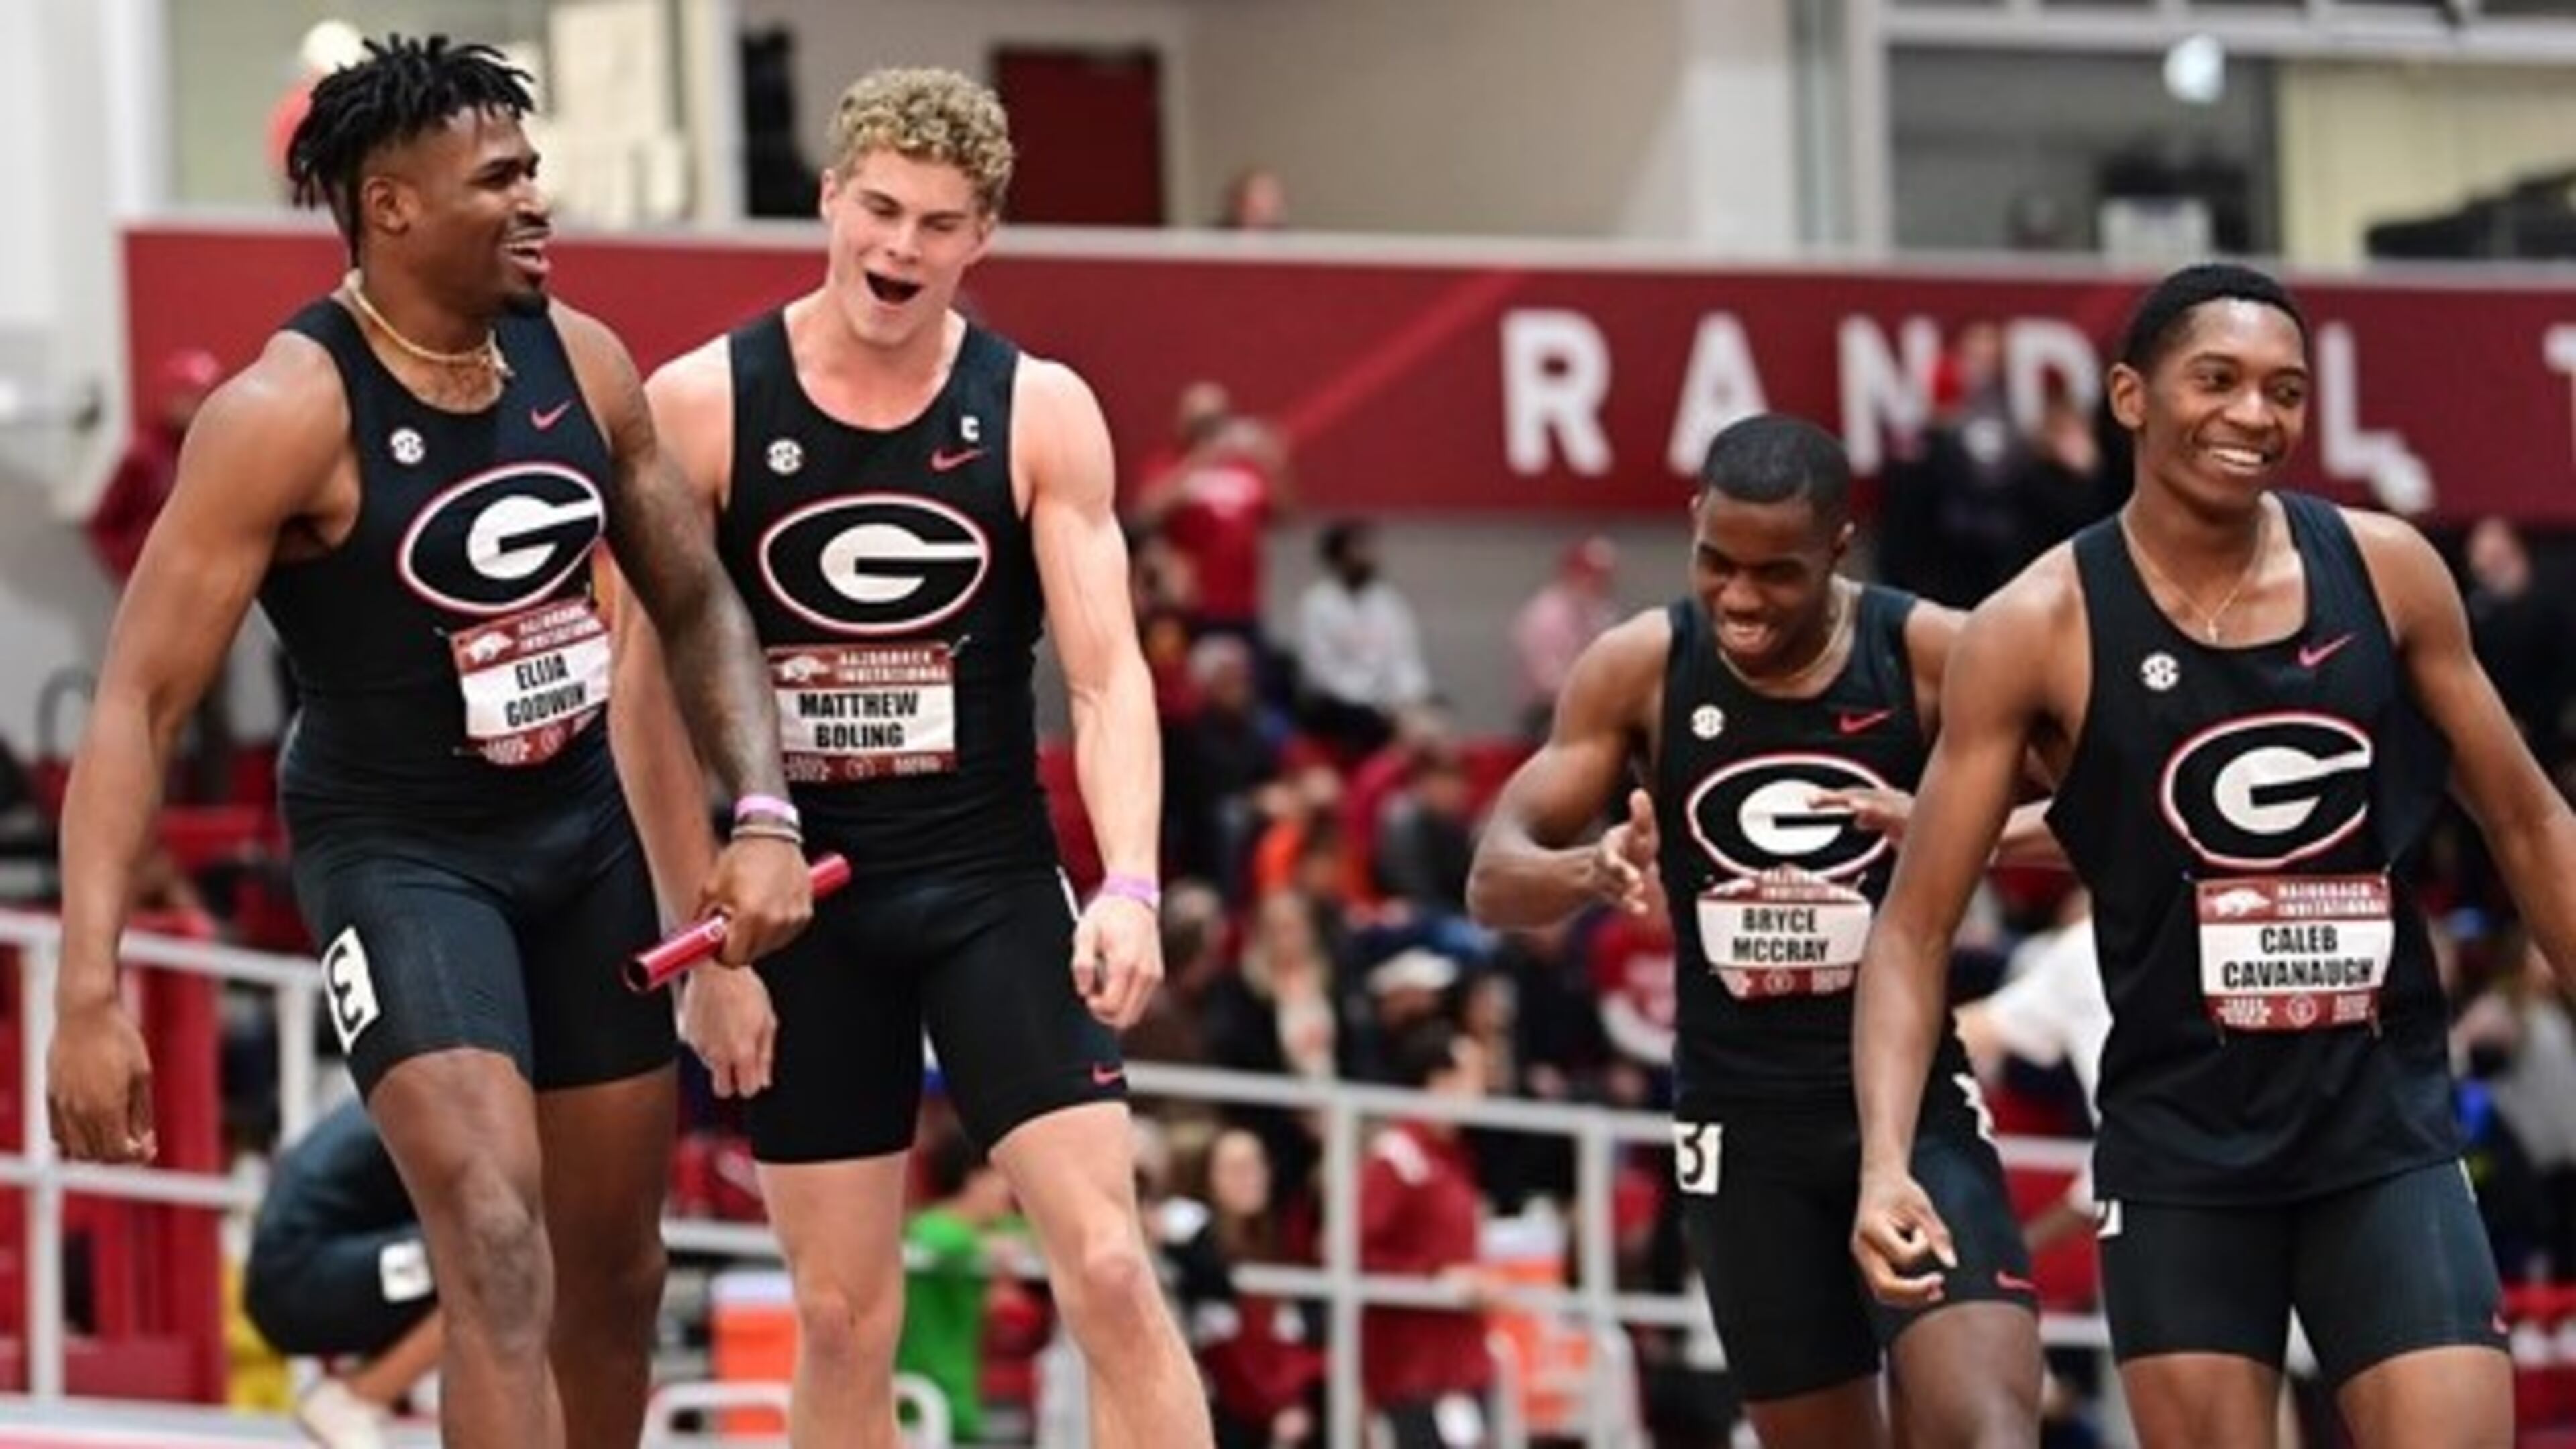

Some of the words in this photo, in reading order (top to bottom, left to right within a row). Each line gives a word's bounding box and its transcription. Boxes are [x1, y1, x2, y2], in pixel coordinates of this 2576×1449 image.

[1500, 307, 2405, 478] RANDL
[961, 415, 979, 441] C
[506, 680, 586, 727] GODWIN
[798, 691, 918, 718] MATTHEW
[816, 722, 904, 749] BOLING
[1743, 908, 1817, 932] BRYCE
[1733, 937, 1829, 962] MCCRAY
[2261, 925, 2337, 954] CALEB
[2222, 957, 2374, 989] CAVANAUGH
[329, 943, 363, 1034] 3
